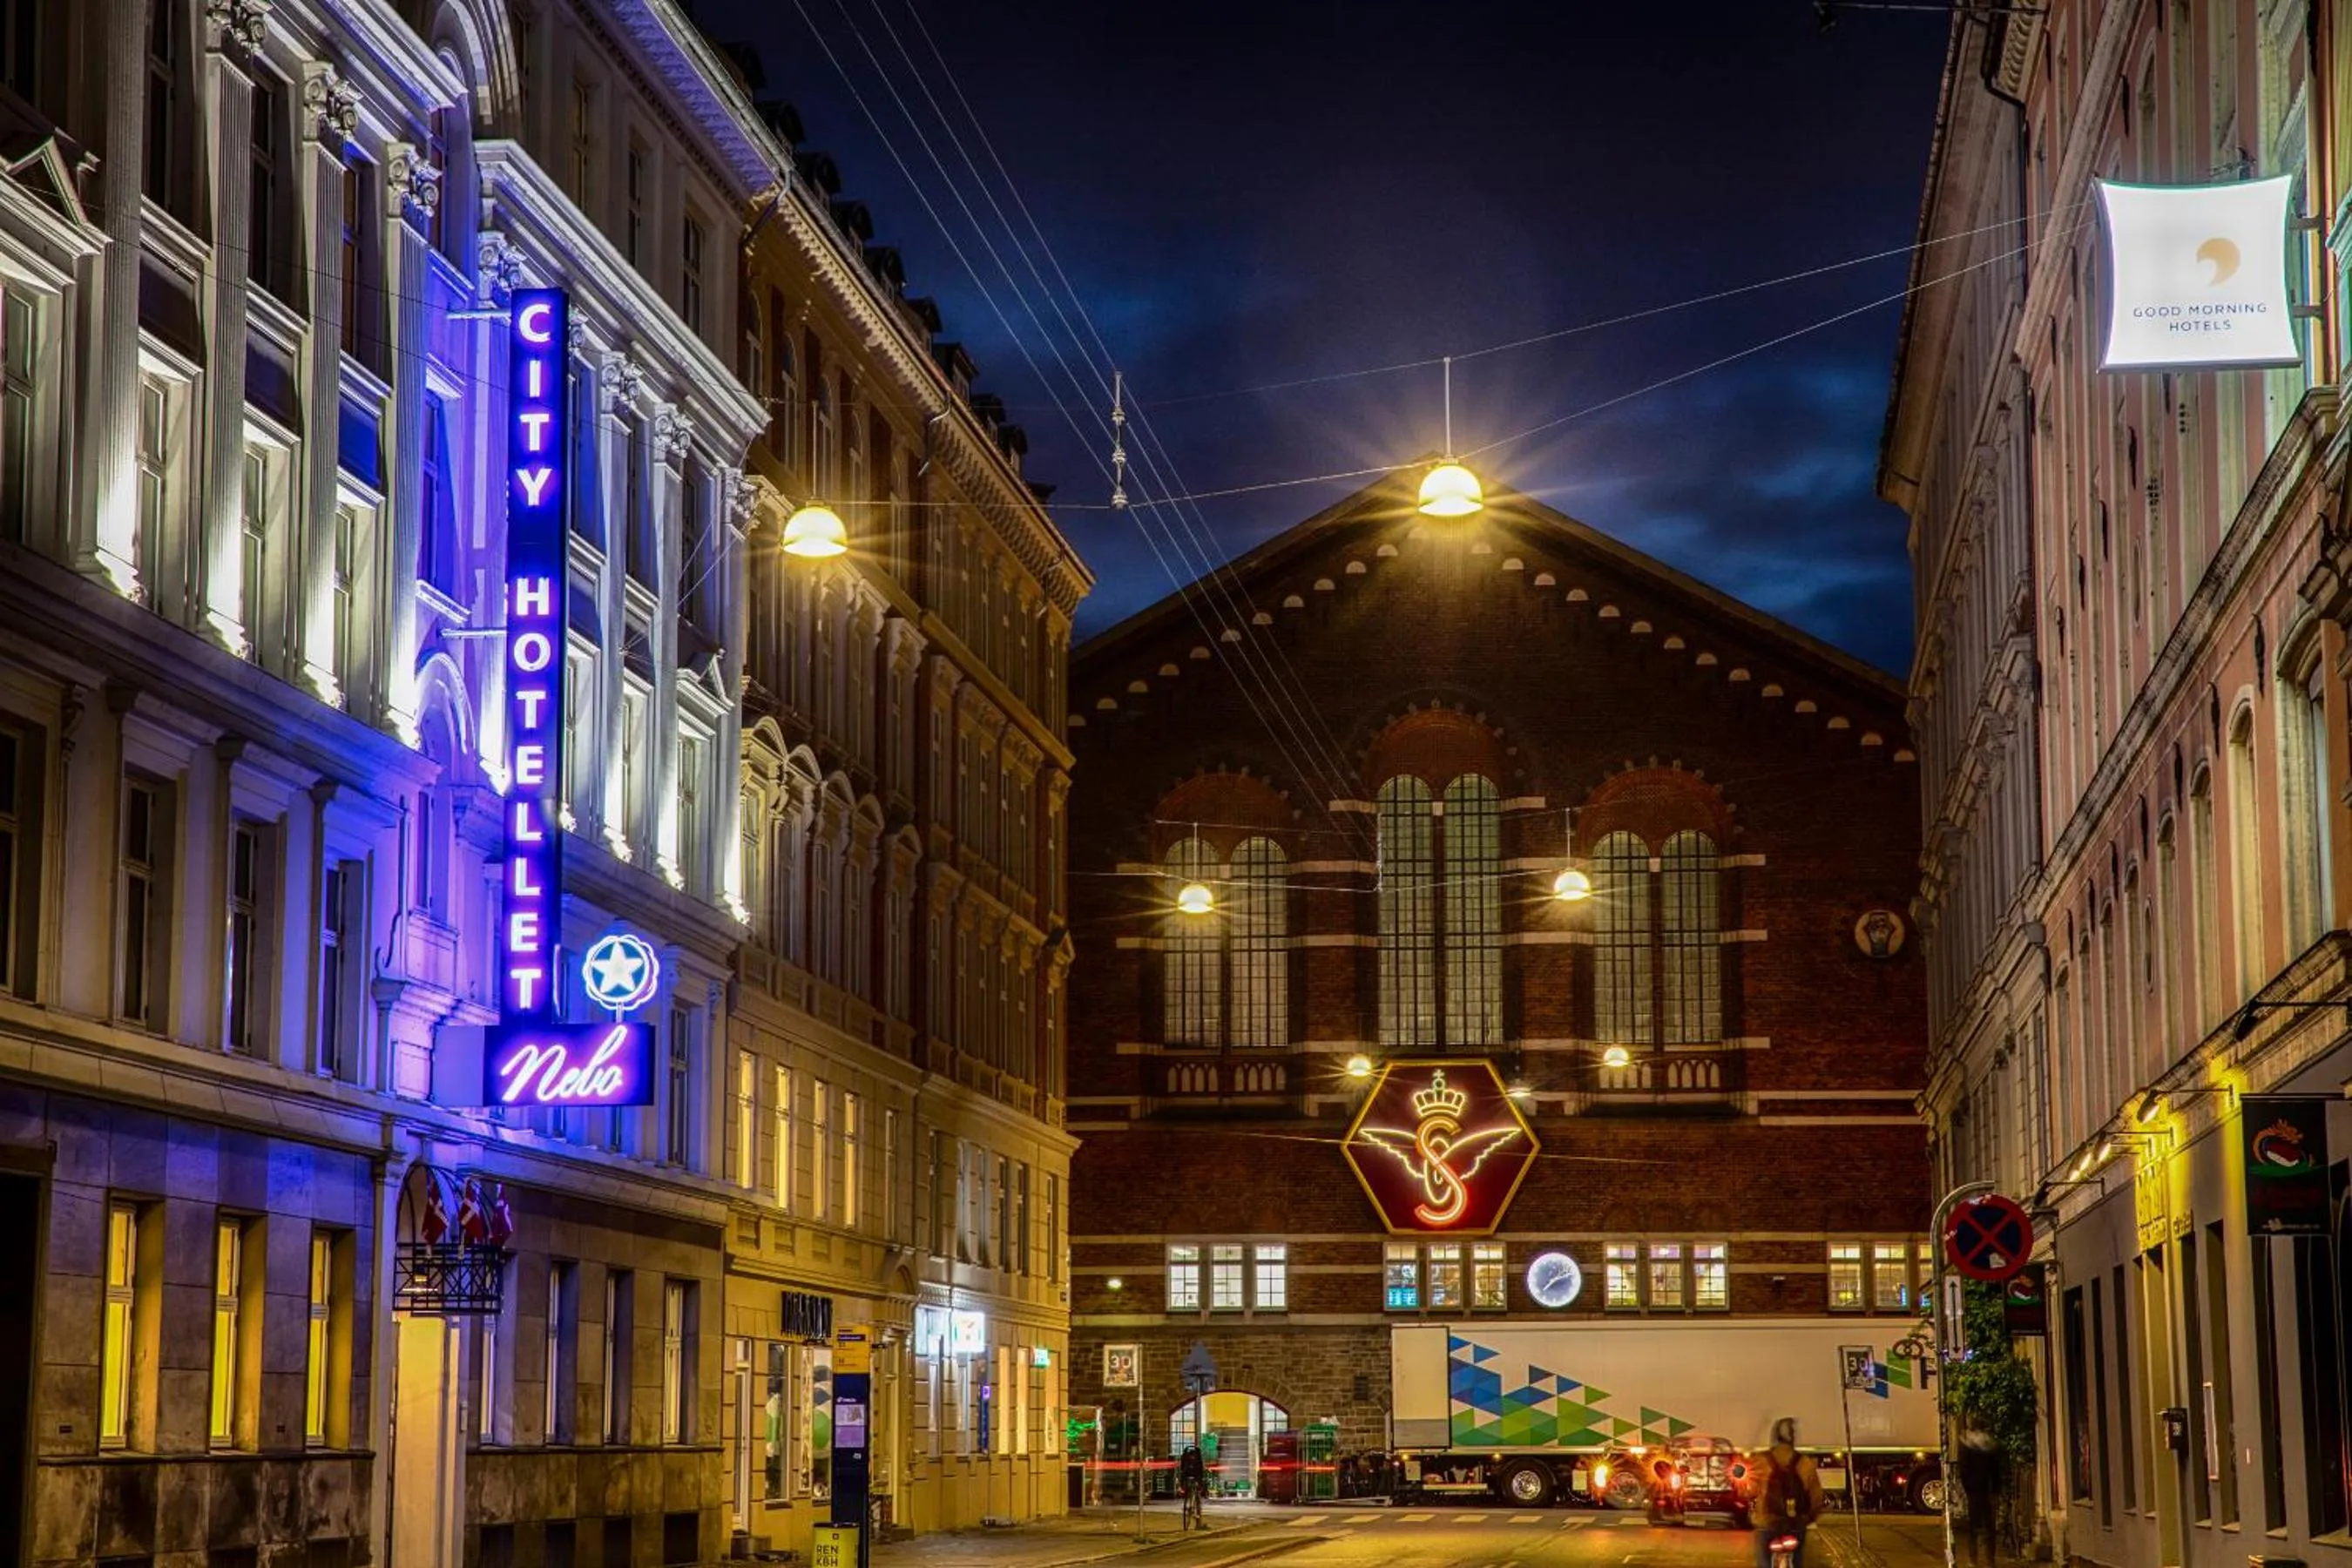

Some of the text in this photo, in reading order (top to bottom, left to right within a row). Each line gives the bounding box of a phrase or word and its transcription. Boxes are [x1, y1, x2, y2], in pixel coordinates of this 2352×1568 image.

[2132, 302, 2268, 318] GOOD MORNING
[2169, 320, 2232, 332] HOTELS
[509, 303, 552, 1010] CITY HOTELLET
[499, 1024, 628, 1103] Nebo
[1110, 1355, 1132, 1369] 30
[1848, 1357, 1869, 1371] 30
[815, 1544, 839, 1555] REN
[815, 1556, 839, 1567] KBH
